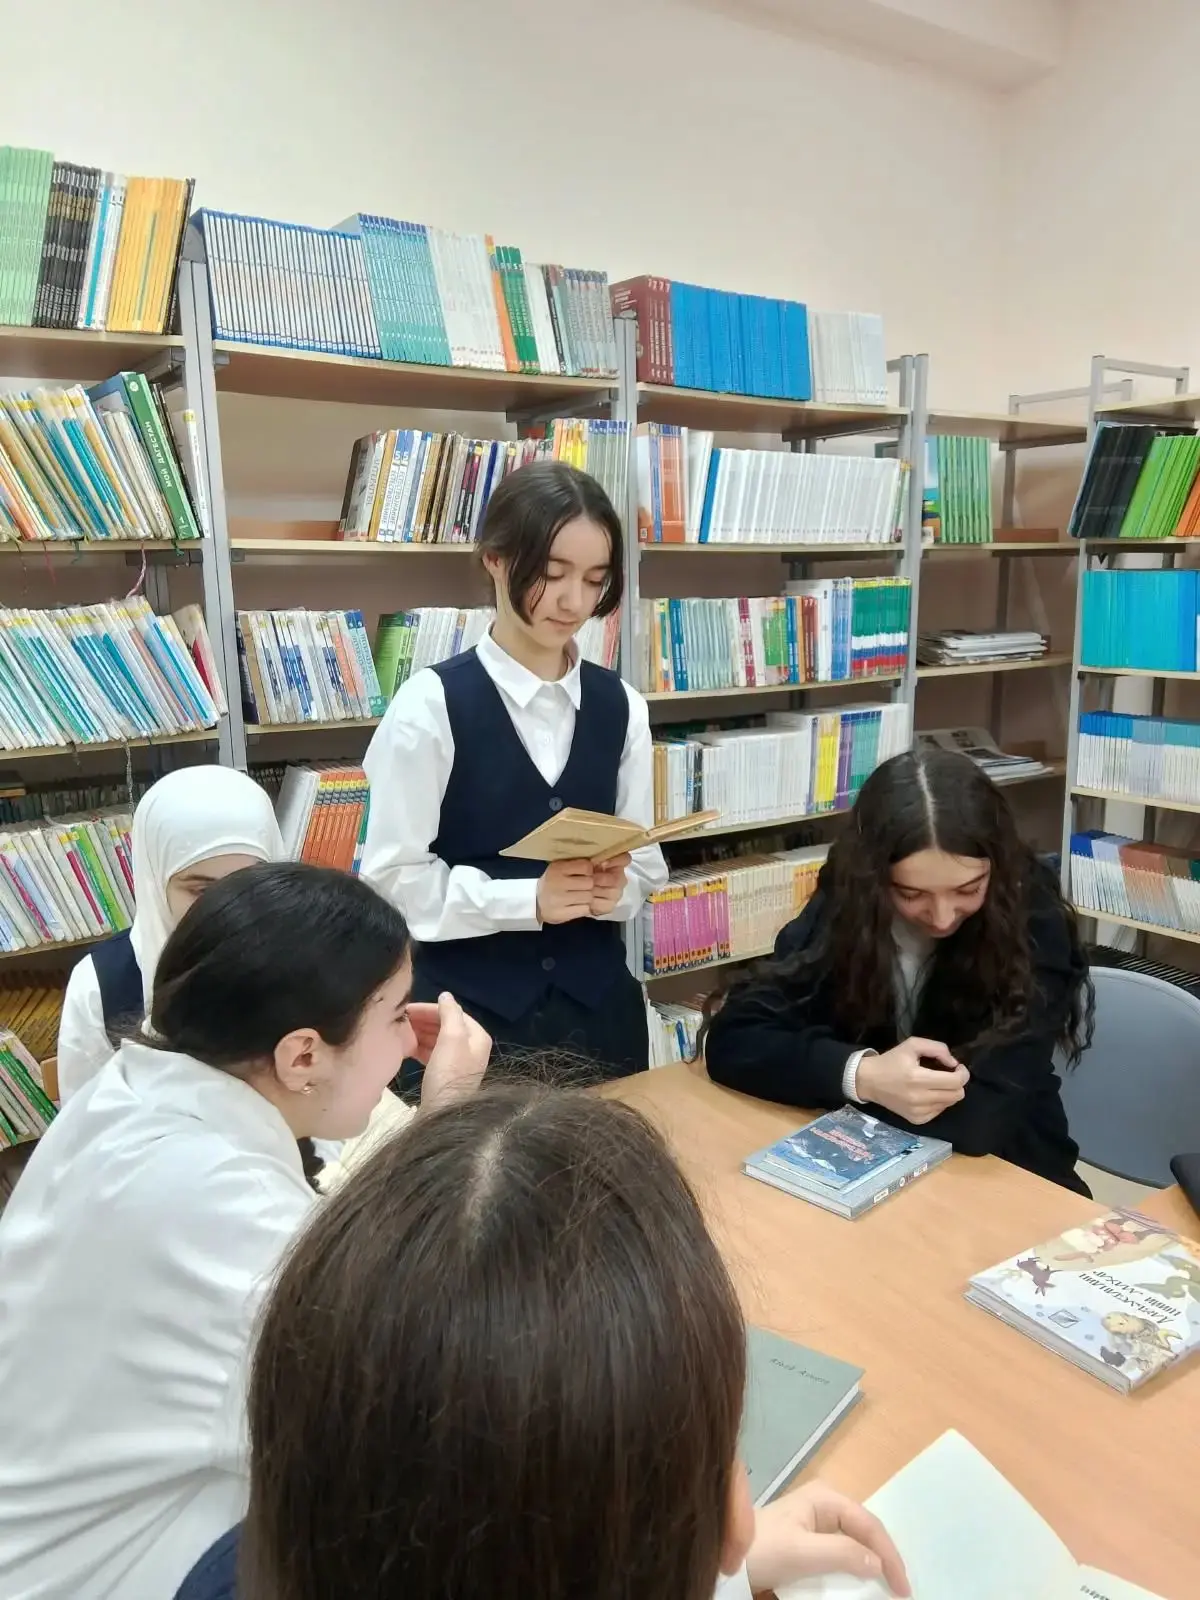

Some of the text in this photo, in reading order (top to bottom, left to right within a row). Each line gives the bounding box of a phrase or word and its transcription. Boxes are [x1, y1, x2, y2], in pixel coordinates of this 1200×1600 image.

[144, 421, 173, 488] МОЙ ДАГЕСТАН
[395, 451, 402, 460] 5
[403, 451, 410, 460] 5
